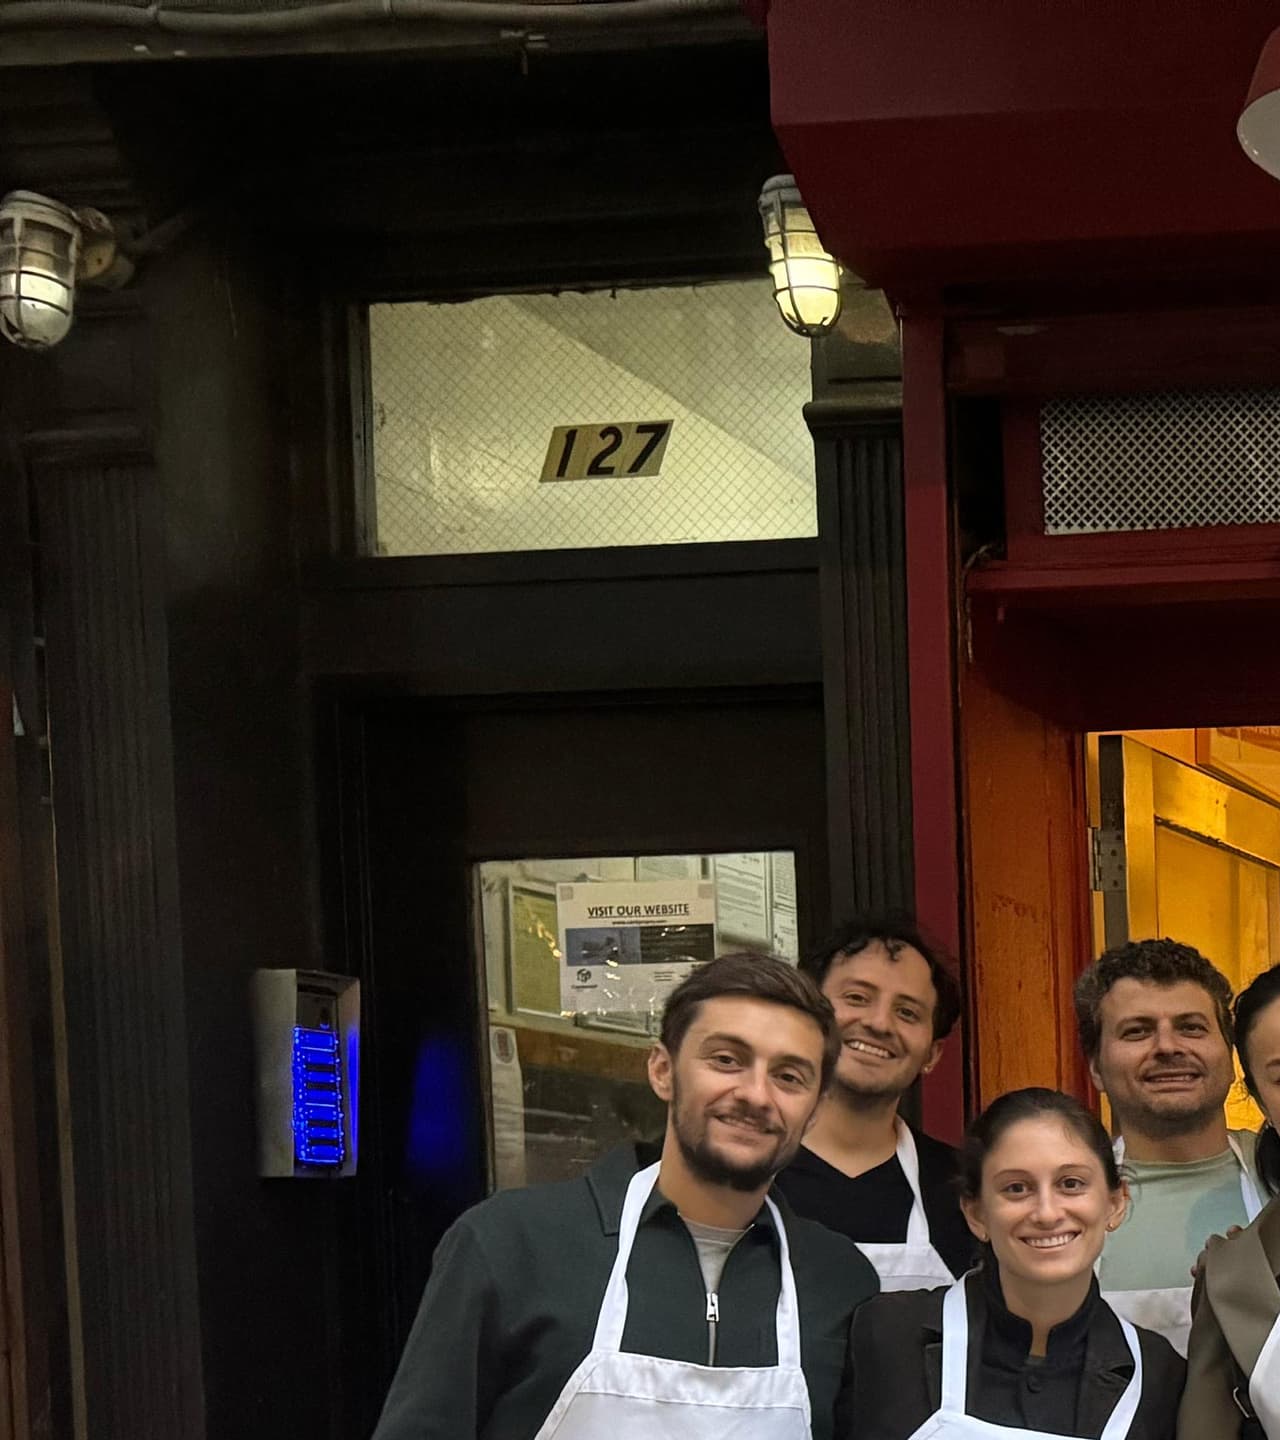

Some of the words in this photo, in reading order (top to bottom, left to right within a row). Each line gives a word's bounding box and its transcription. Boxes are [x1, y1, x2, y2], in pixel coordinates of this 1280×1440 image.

[556, 422, 670, 478] 127
[587, 905, 614, 917] VISIT
[616, 905, 642, 916] OUR
[644, 903, 690, 916] WEBSITE
